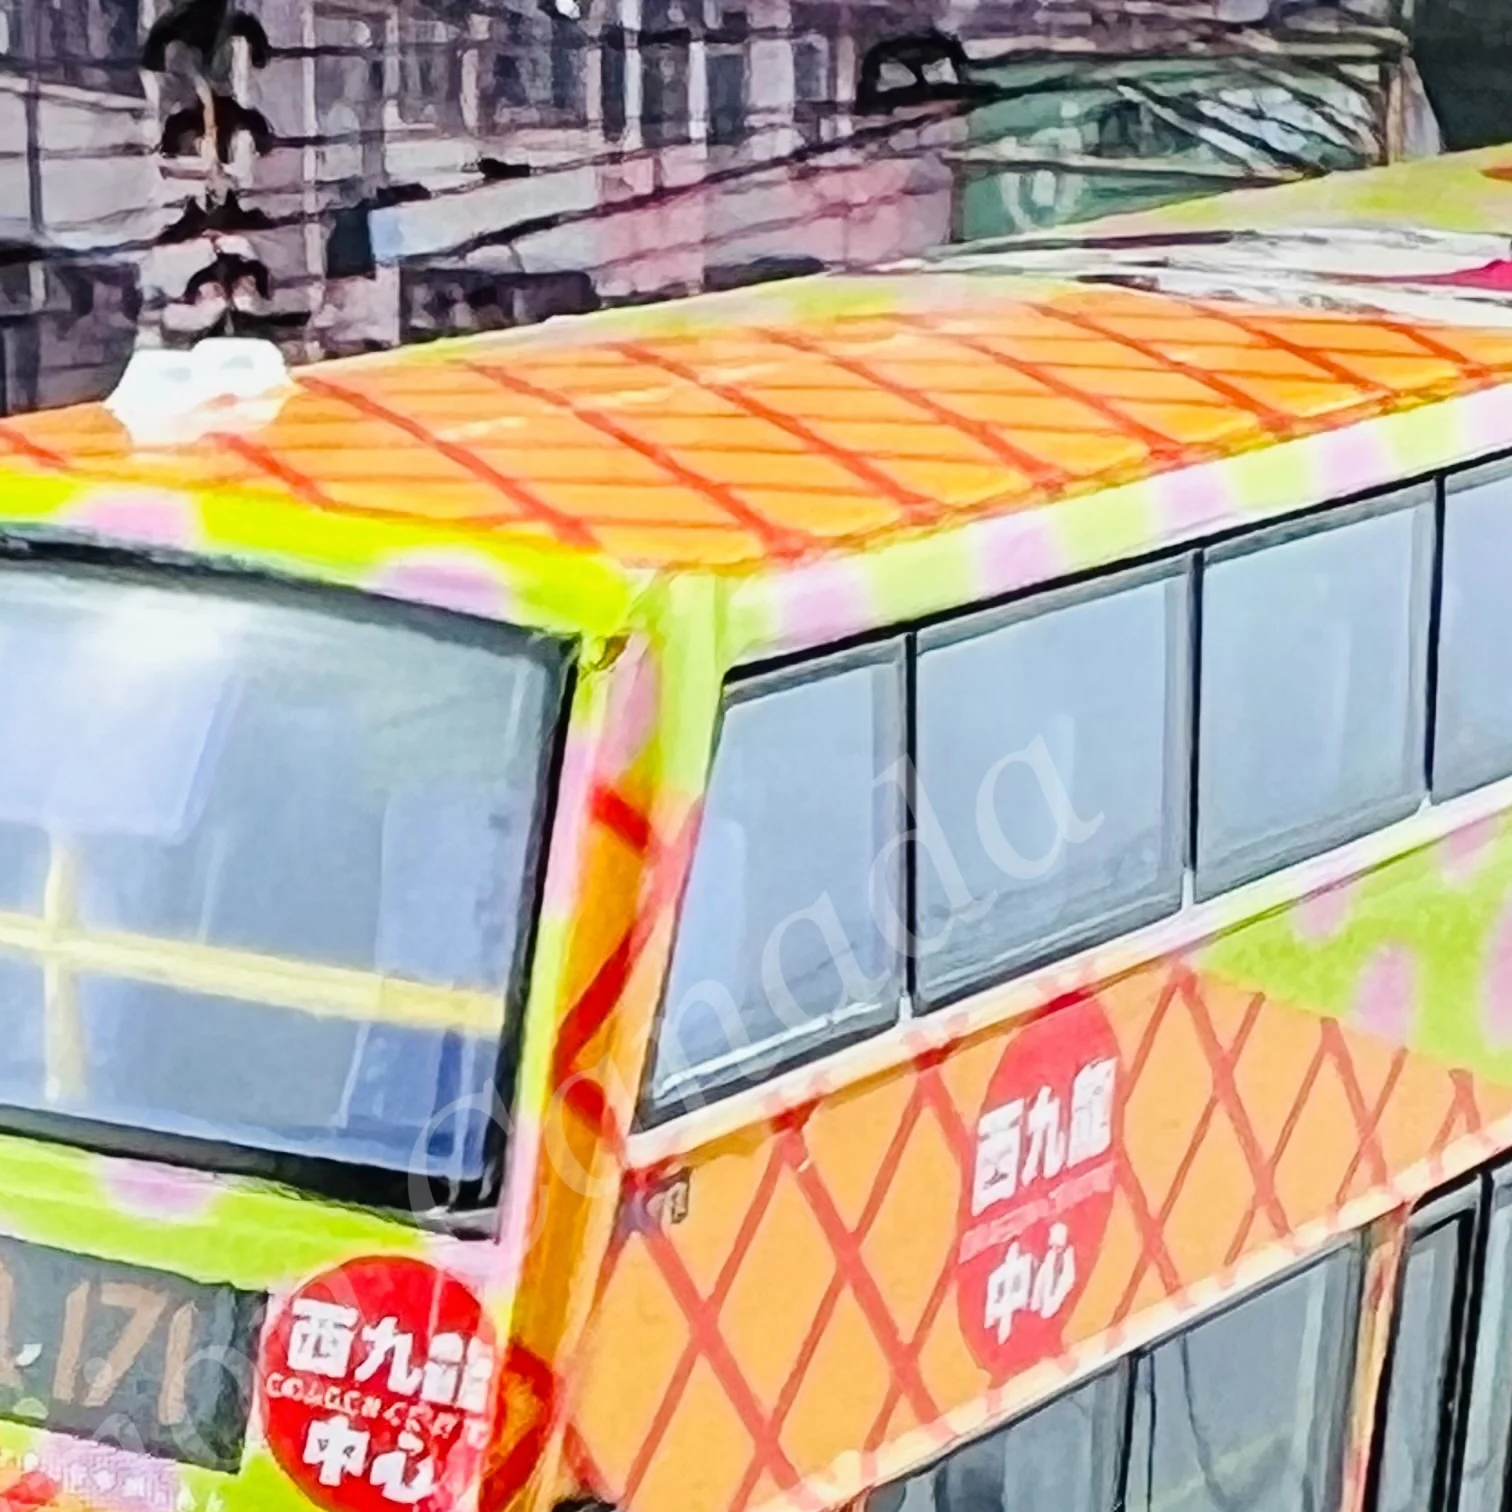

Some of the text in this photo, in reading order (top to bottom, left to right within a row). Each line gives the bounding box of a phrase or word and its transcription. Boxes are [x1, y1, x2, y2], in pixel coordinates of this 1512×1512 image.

[984, 1222, 1076, 1346] 中心
[52, 1276, 195, 1425] 171
[302, 1415, 435, 1504] 中心
